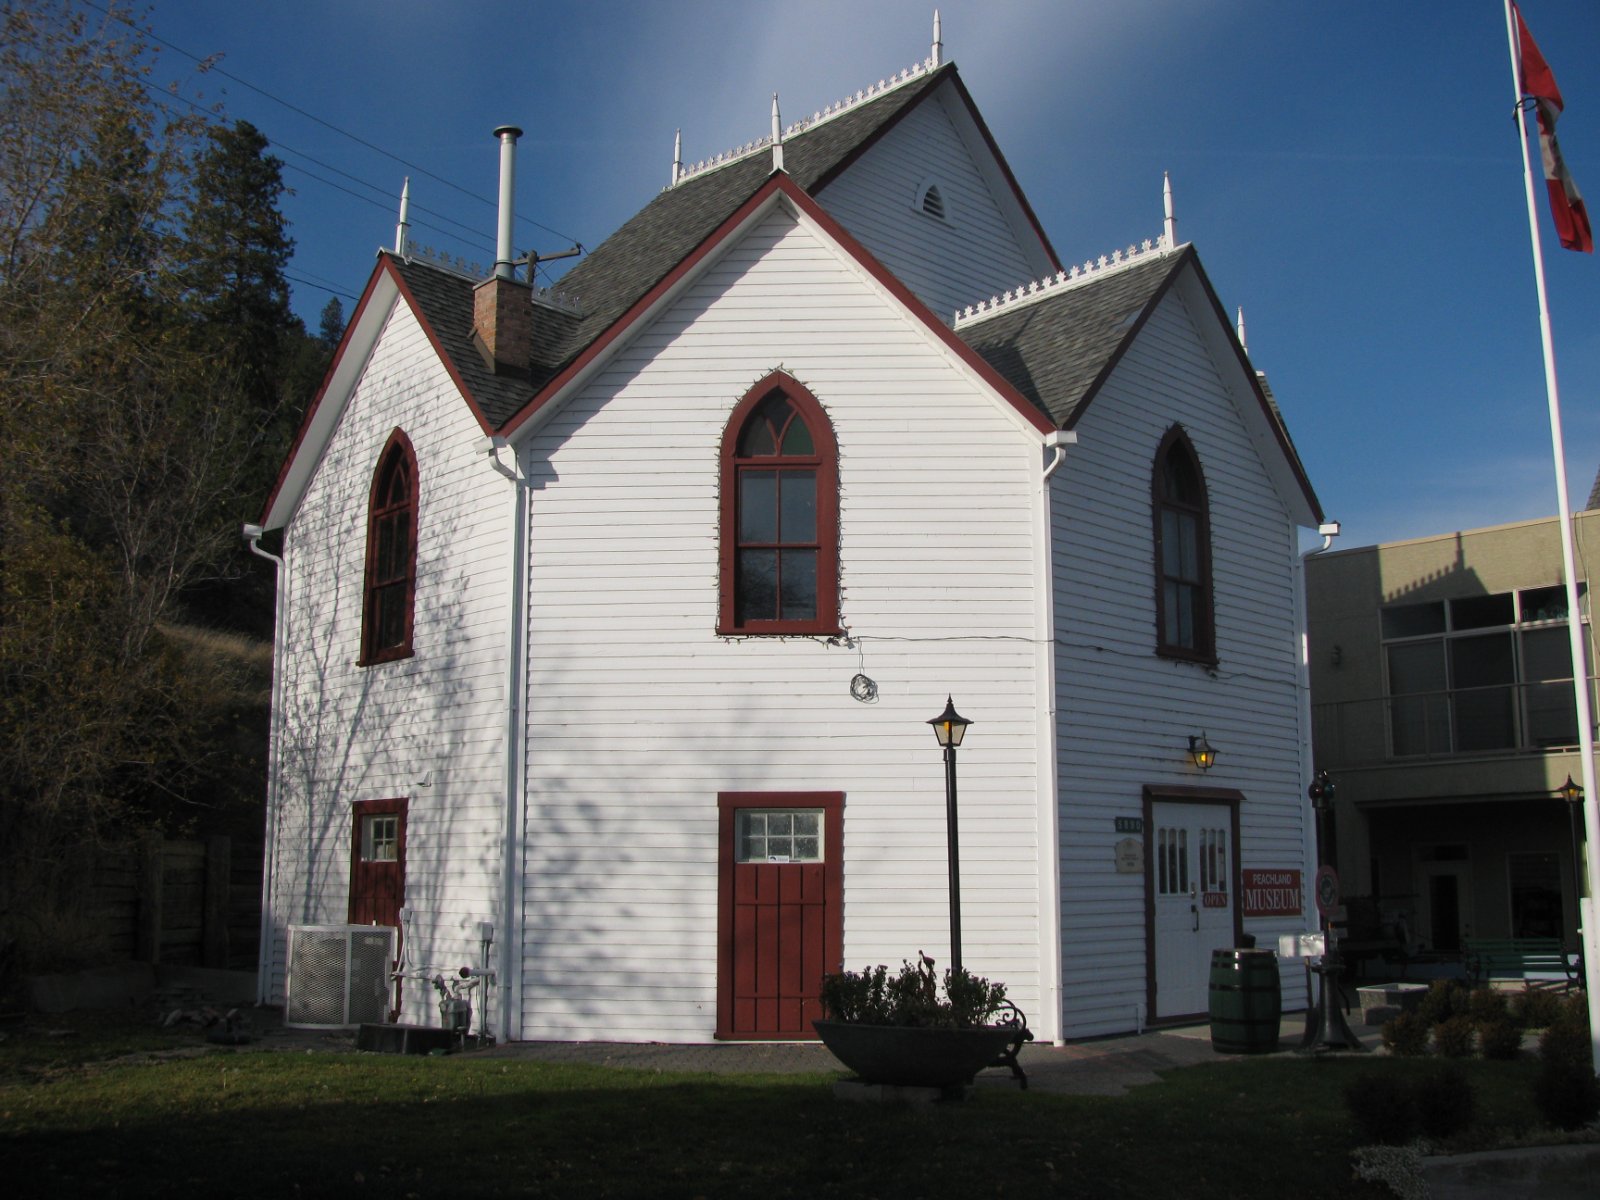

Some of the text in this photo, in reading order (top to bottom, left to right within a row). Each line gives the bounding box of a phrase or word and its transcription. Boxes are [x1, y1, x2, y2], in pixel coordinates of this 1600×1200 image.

[1252, 873, 1291, 885] PEACHLAND
[1204, 894, 1226, 905] OPEN
[1246, 888, 1300, 910] MUSEUM
